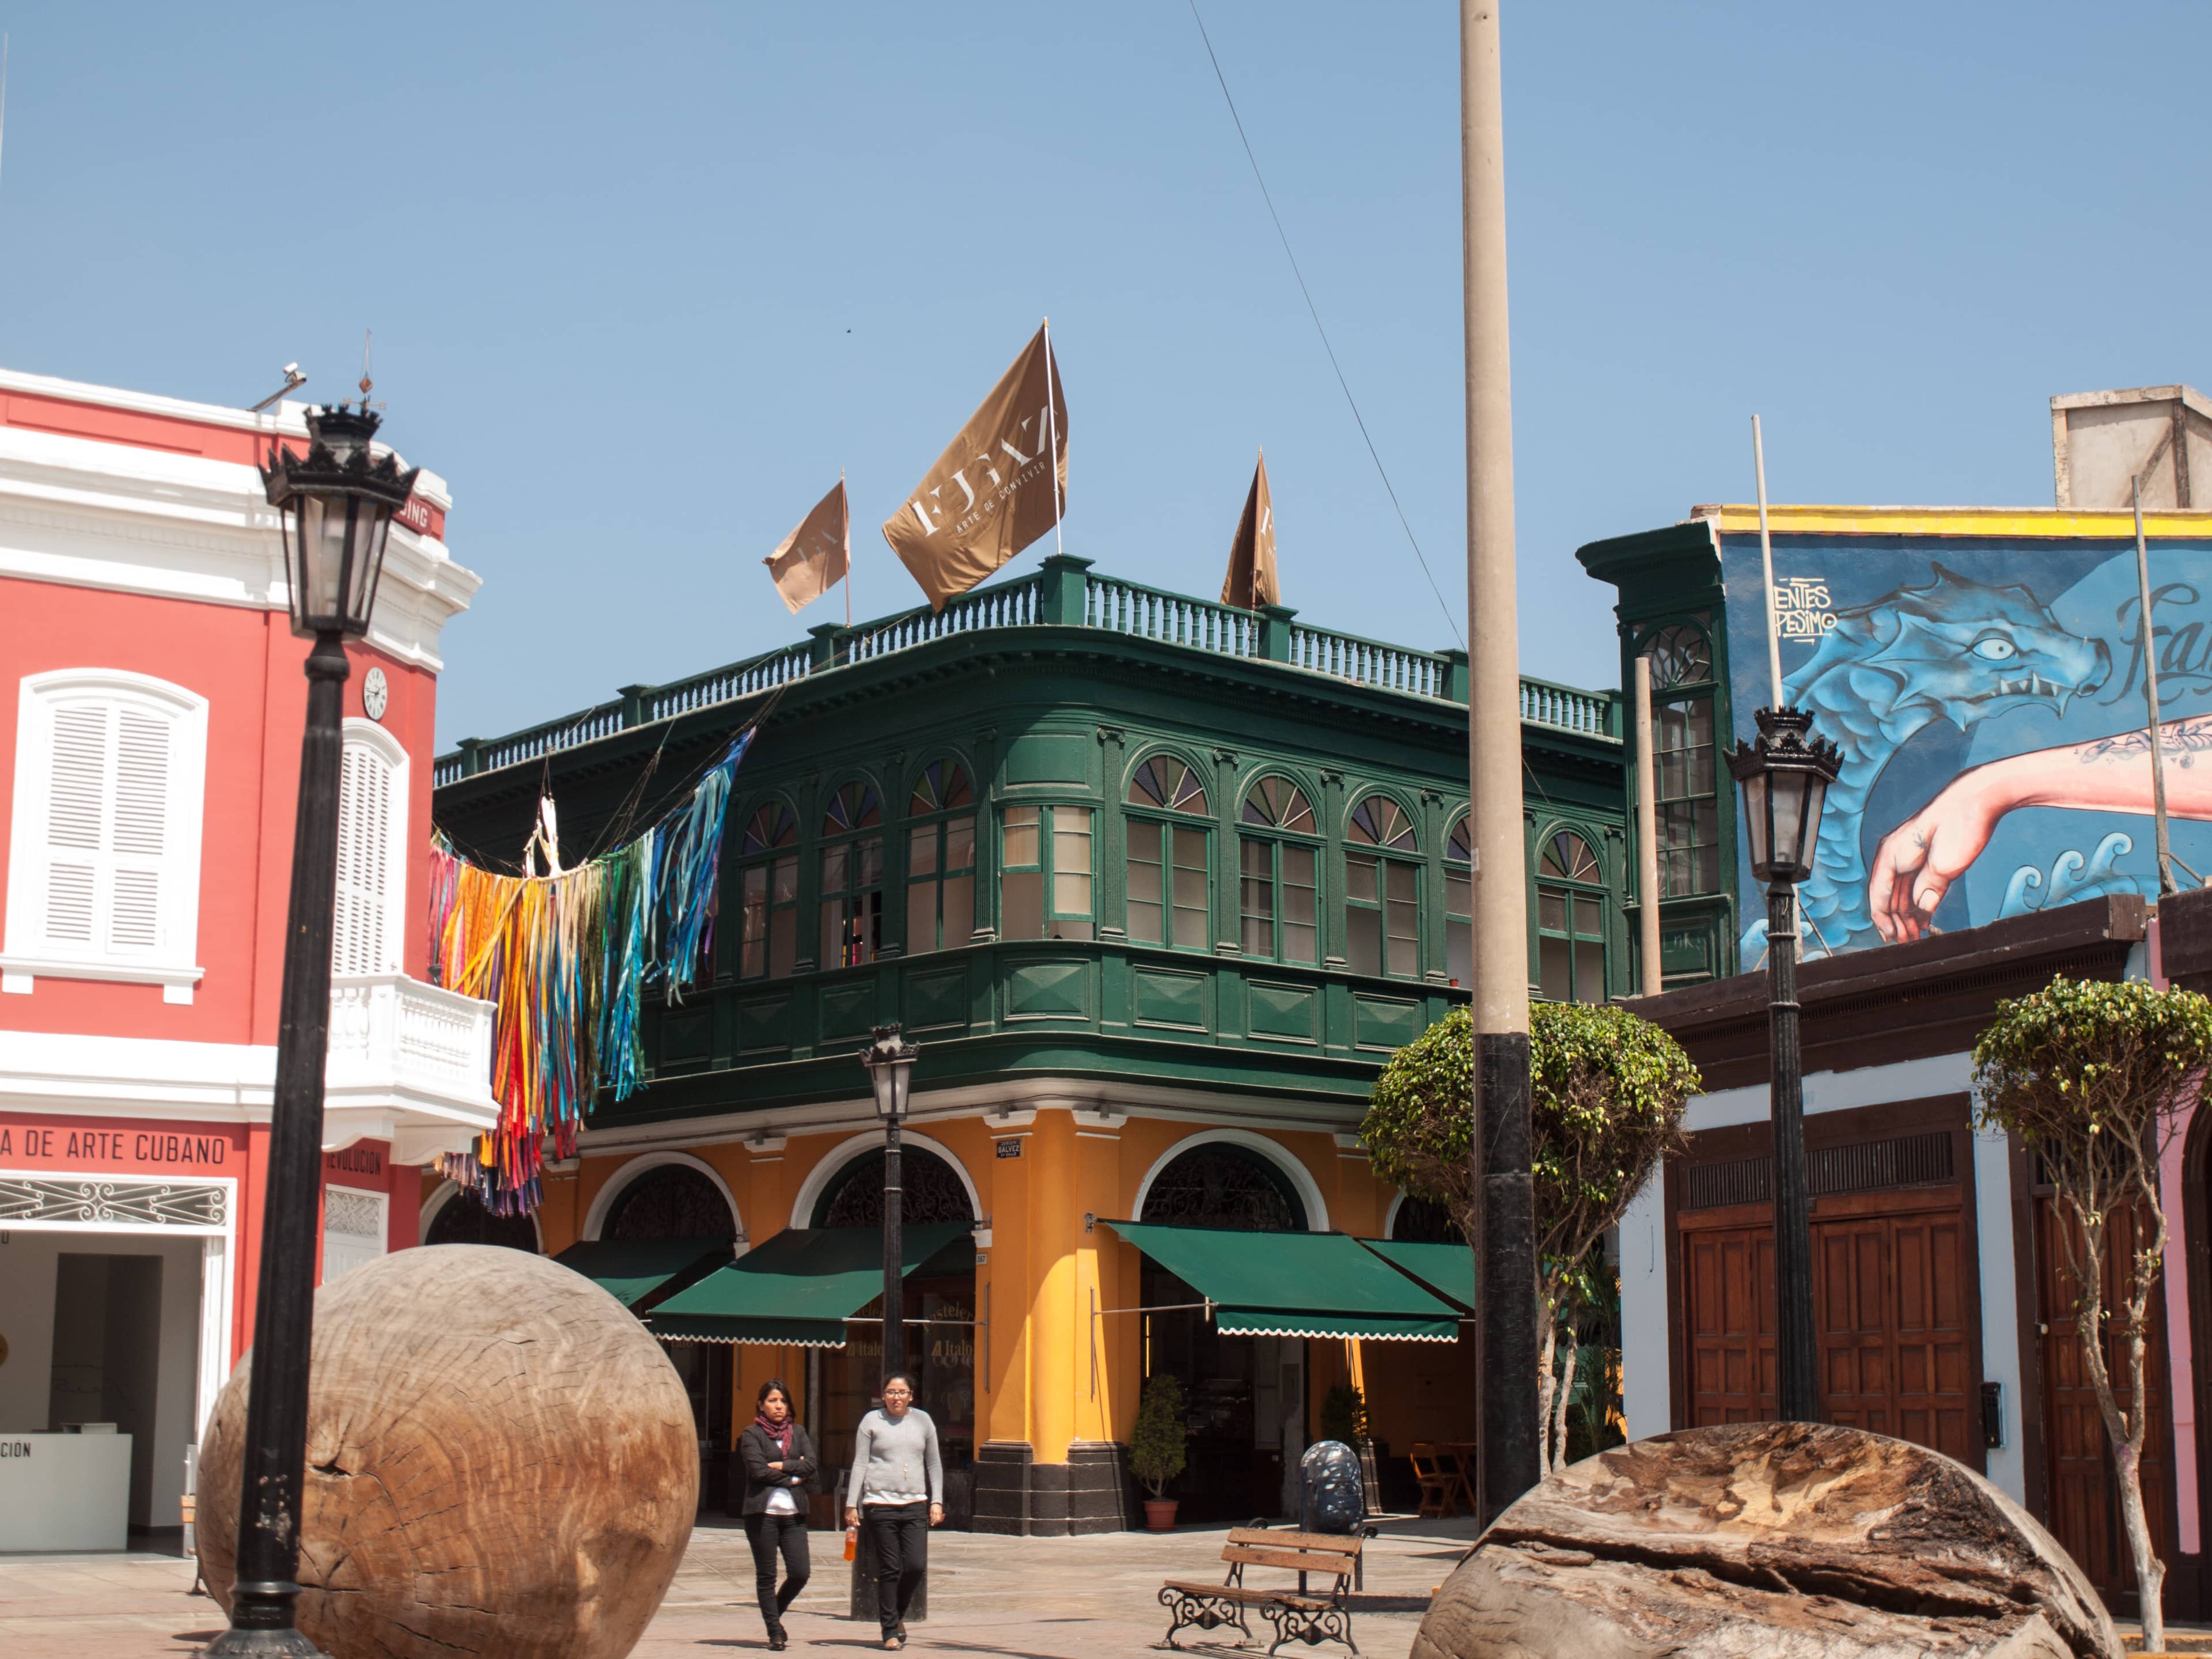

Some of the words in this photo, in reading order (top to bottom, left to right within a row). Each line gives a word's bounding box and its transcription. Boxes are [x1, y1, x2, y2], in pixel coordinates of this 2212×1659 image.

[956, 511, 980, 533] ARTE
[984, 499, 994, 512] DE
[999, 461, 1046, 499] CONVIVIR
[1774, 582, 1831, 609] ENTES
[26, 1130, 54, 1157] DE
[67, 1132, 123, 1160] ARTE
[136, 1134, 224, 1164] CUBANO
